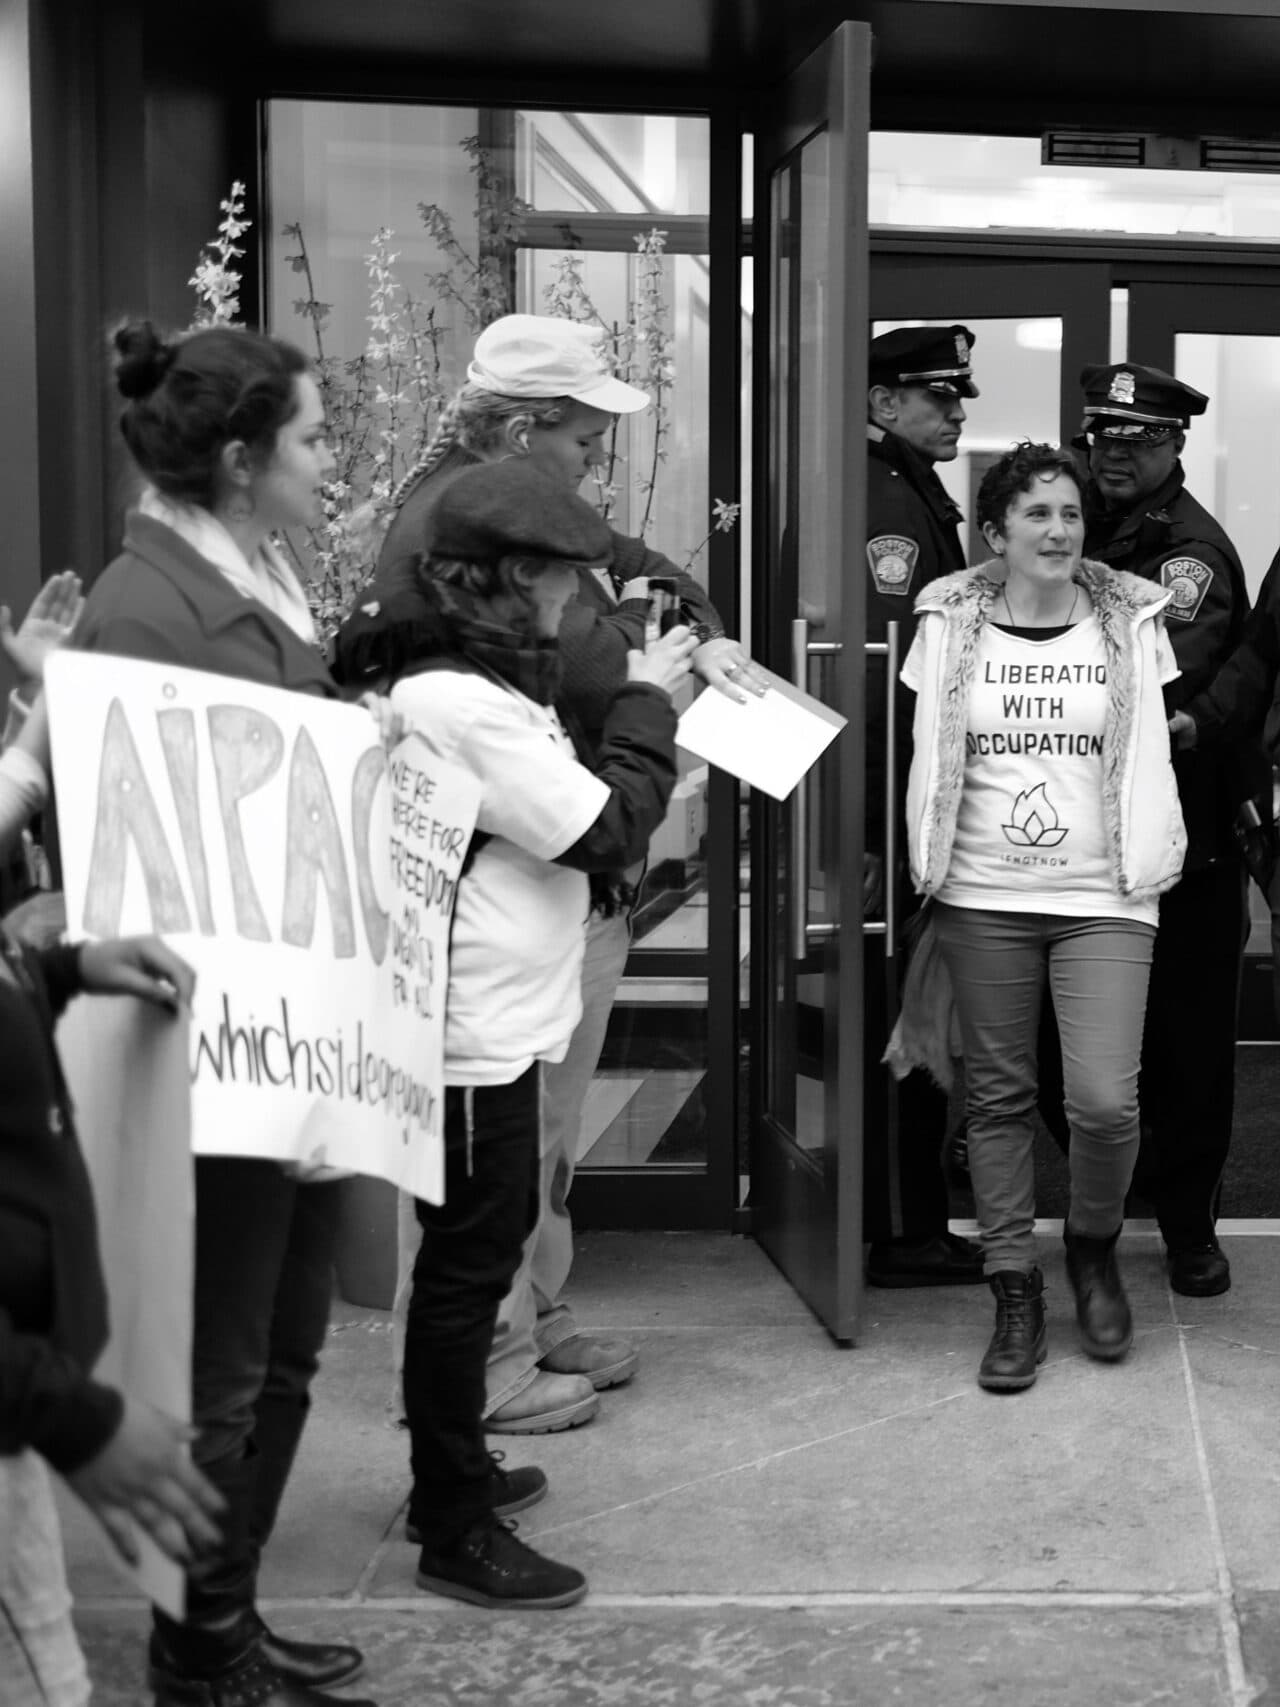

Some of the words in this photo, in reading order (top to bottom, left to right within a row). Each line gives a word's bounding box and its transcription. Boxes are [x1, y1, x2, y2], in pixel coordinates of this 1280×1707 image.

[984, 660, 1106, 685] LIBERATIO
[1003, 694, 1063, 719] WITH
[429, 819, 466, 860] FOR
